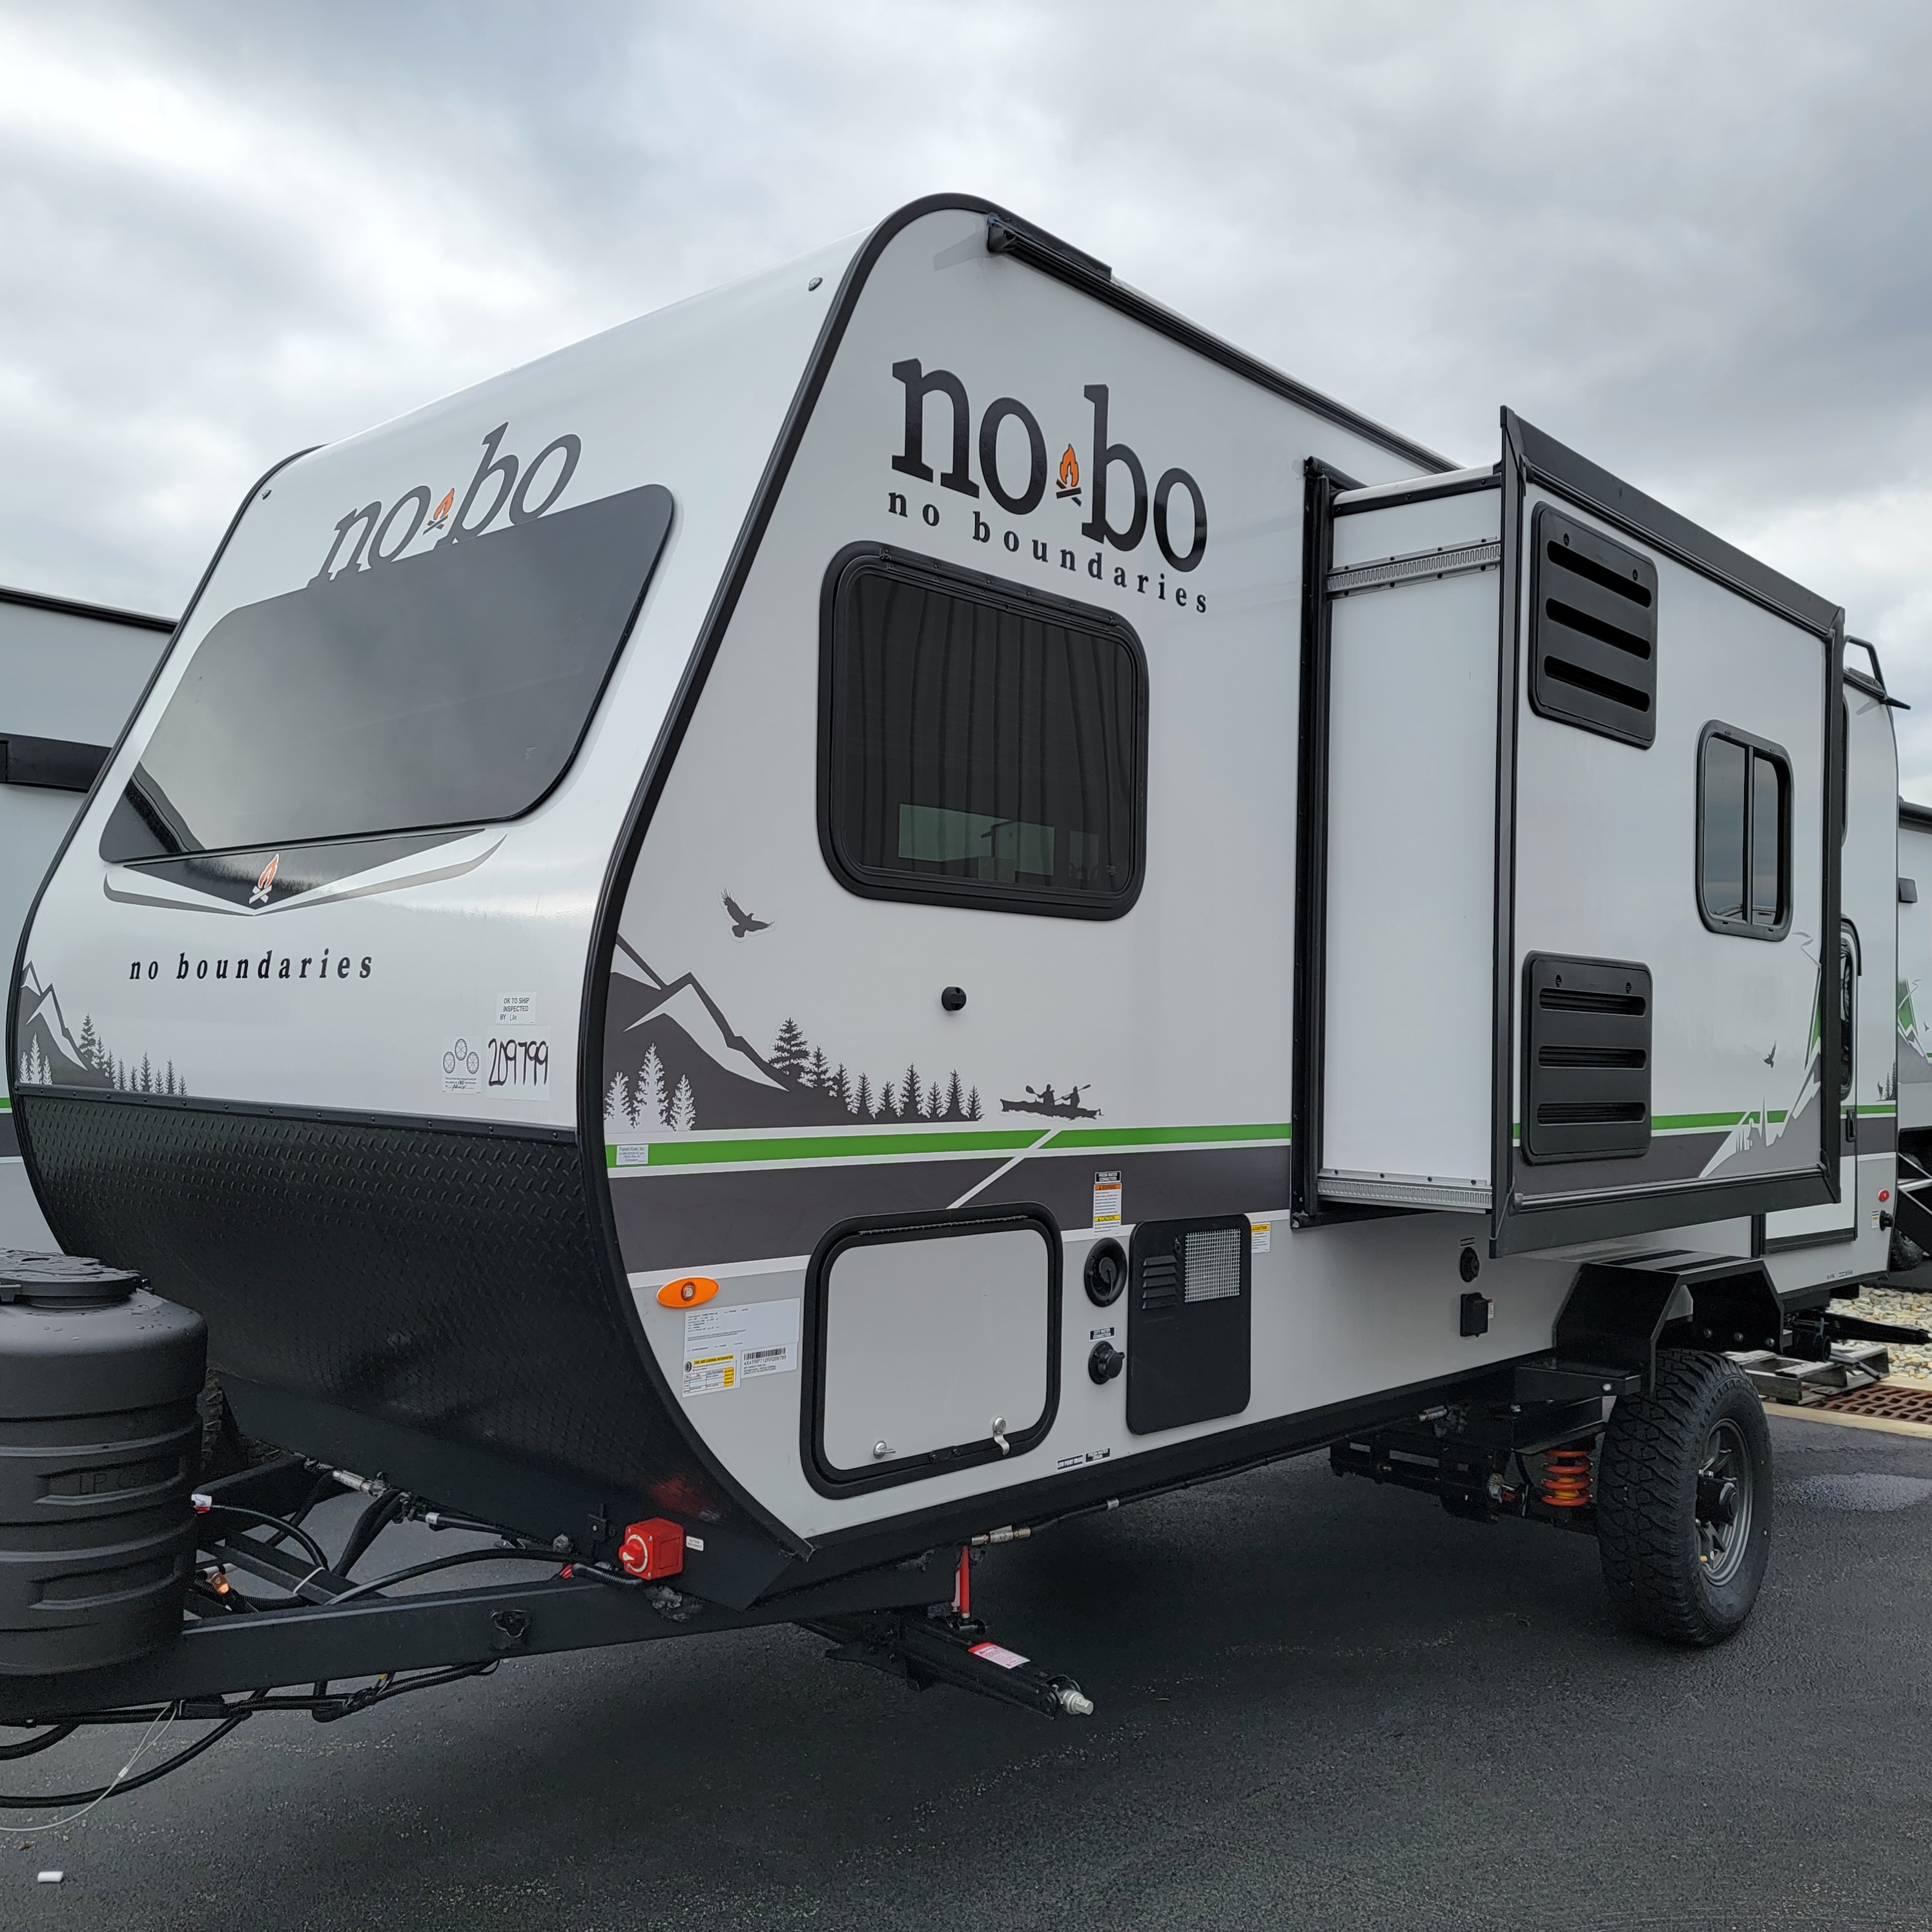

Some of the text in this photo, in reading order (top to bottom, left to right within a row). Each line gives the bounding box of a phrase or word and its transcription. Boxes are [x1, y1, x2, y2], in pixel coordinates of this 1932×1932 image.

[889, 491, 1207, 613] no boundaries
[129, 948, 373, 980] no boundaries
[488, 1038, 549, 1087] 209799
